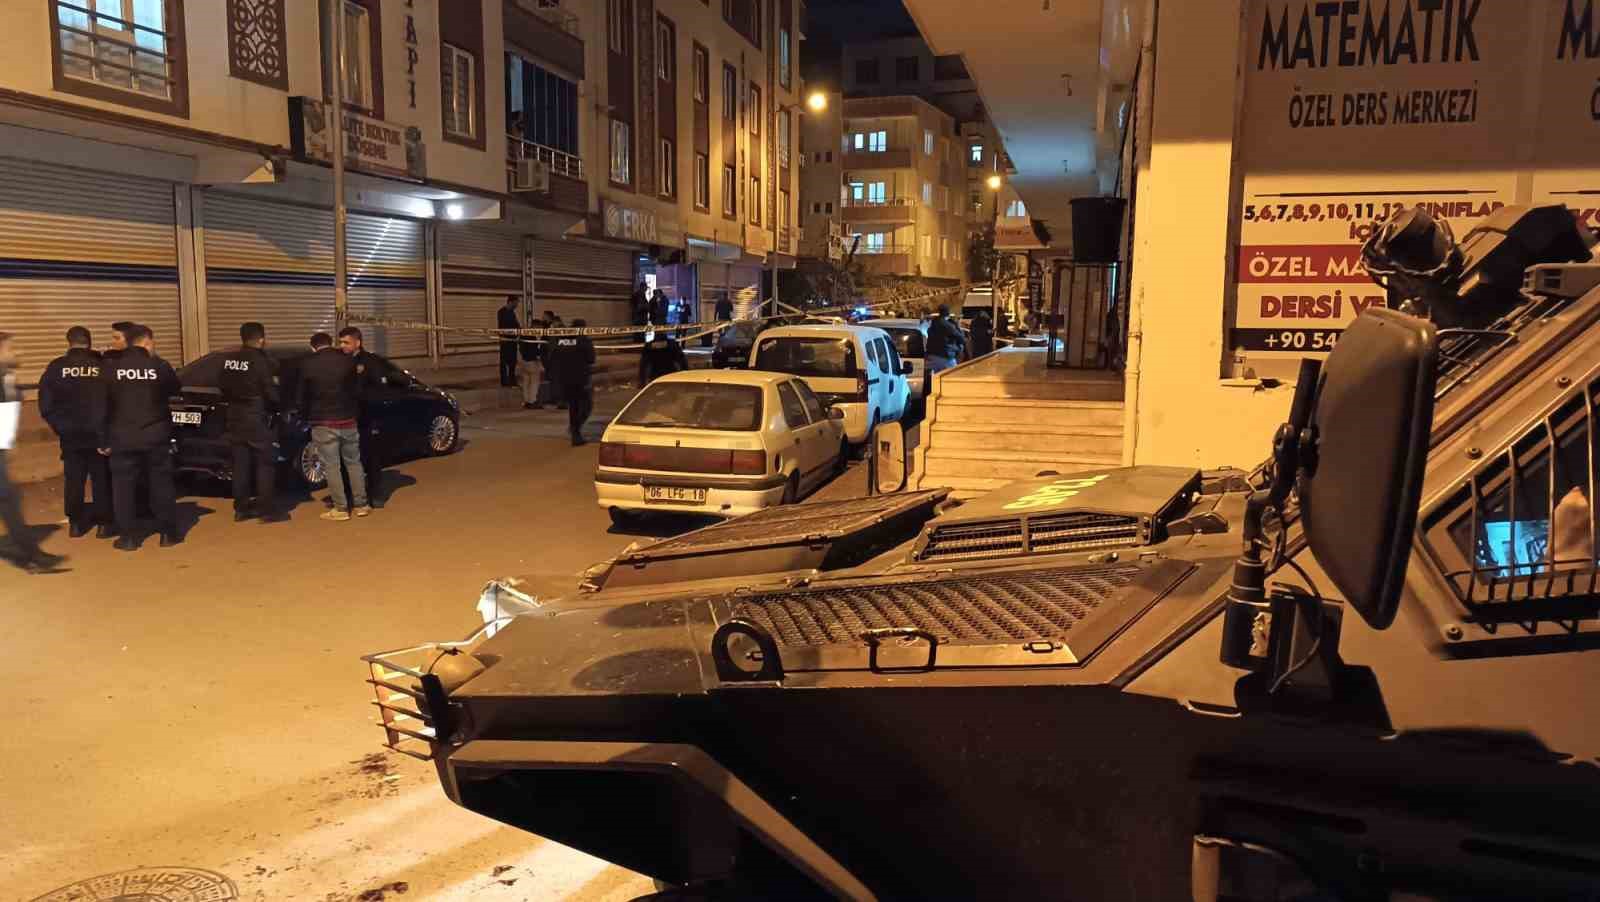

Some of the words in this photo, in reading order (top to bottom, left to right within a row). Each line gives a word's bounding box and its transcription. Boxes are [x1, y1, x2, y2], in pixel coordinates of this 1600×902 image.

[405, 0, 418, 108] API
[1289, 85, 1335, 128] ÖZEL
[1341, 91, 1388, 126] DERS
[1392, 80, 1478, 125] MERKEZİ
[624, 209, 657, 240] ERKA
[1249, 251, 1318, 277] ÖZEL
[1325, 258, 1370, 277] MA
[1260, 290, 1342, 318] DERSİ
[1264, 331, 1305, 349] +90
[1311, 331, 1337, 349] 54
[650, 487, 662, 498] 06
[694, 488, 704, 500] 18
